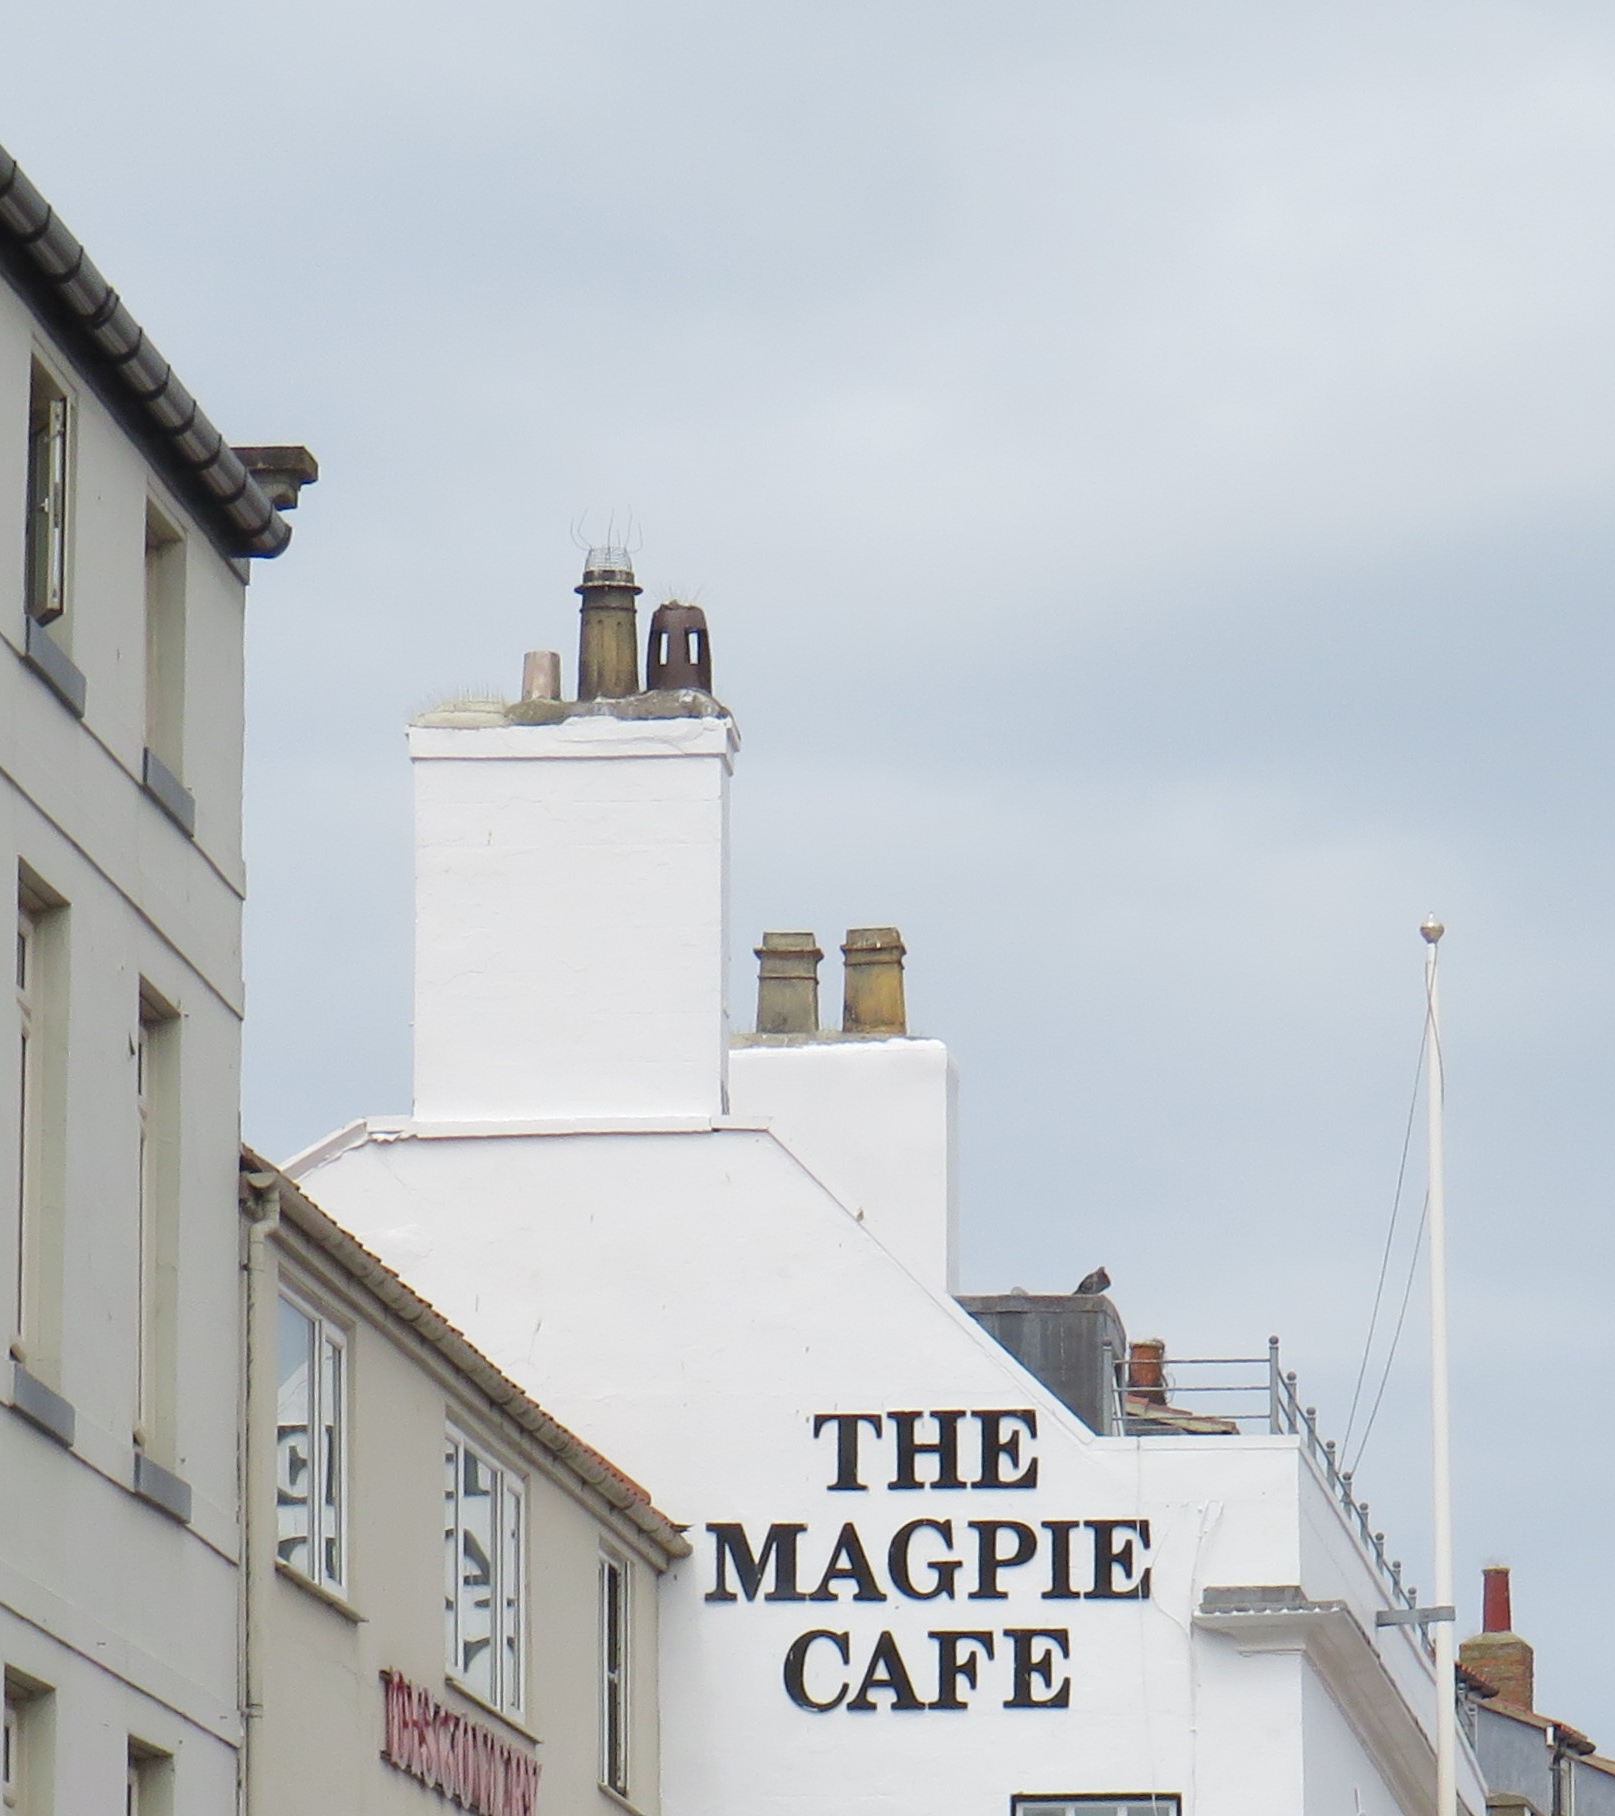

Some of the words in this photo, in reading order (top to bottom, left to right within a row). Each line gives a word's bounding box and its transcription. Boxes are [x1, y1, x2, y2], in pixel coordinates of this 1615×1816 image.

[812, 1408, 1039, 1491] THE
[704, 1518, 1152, 1602] MAGPIE
[783, 1628, 1071, 1714] CAFE
